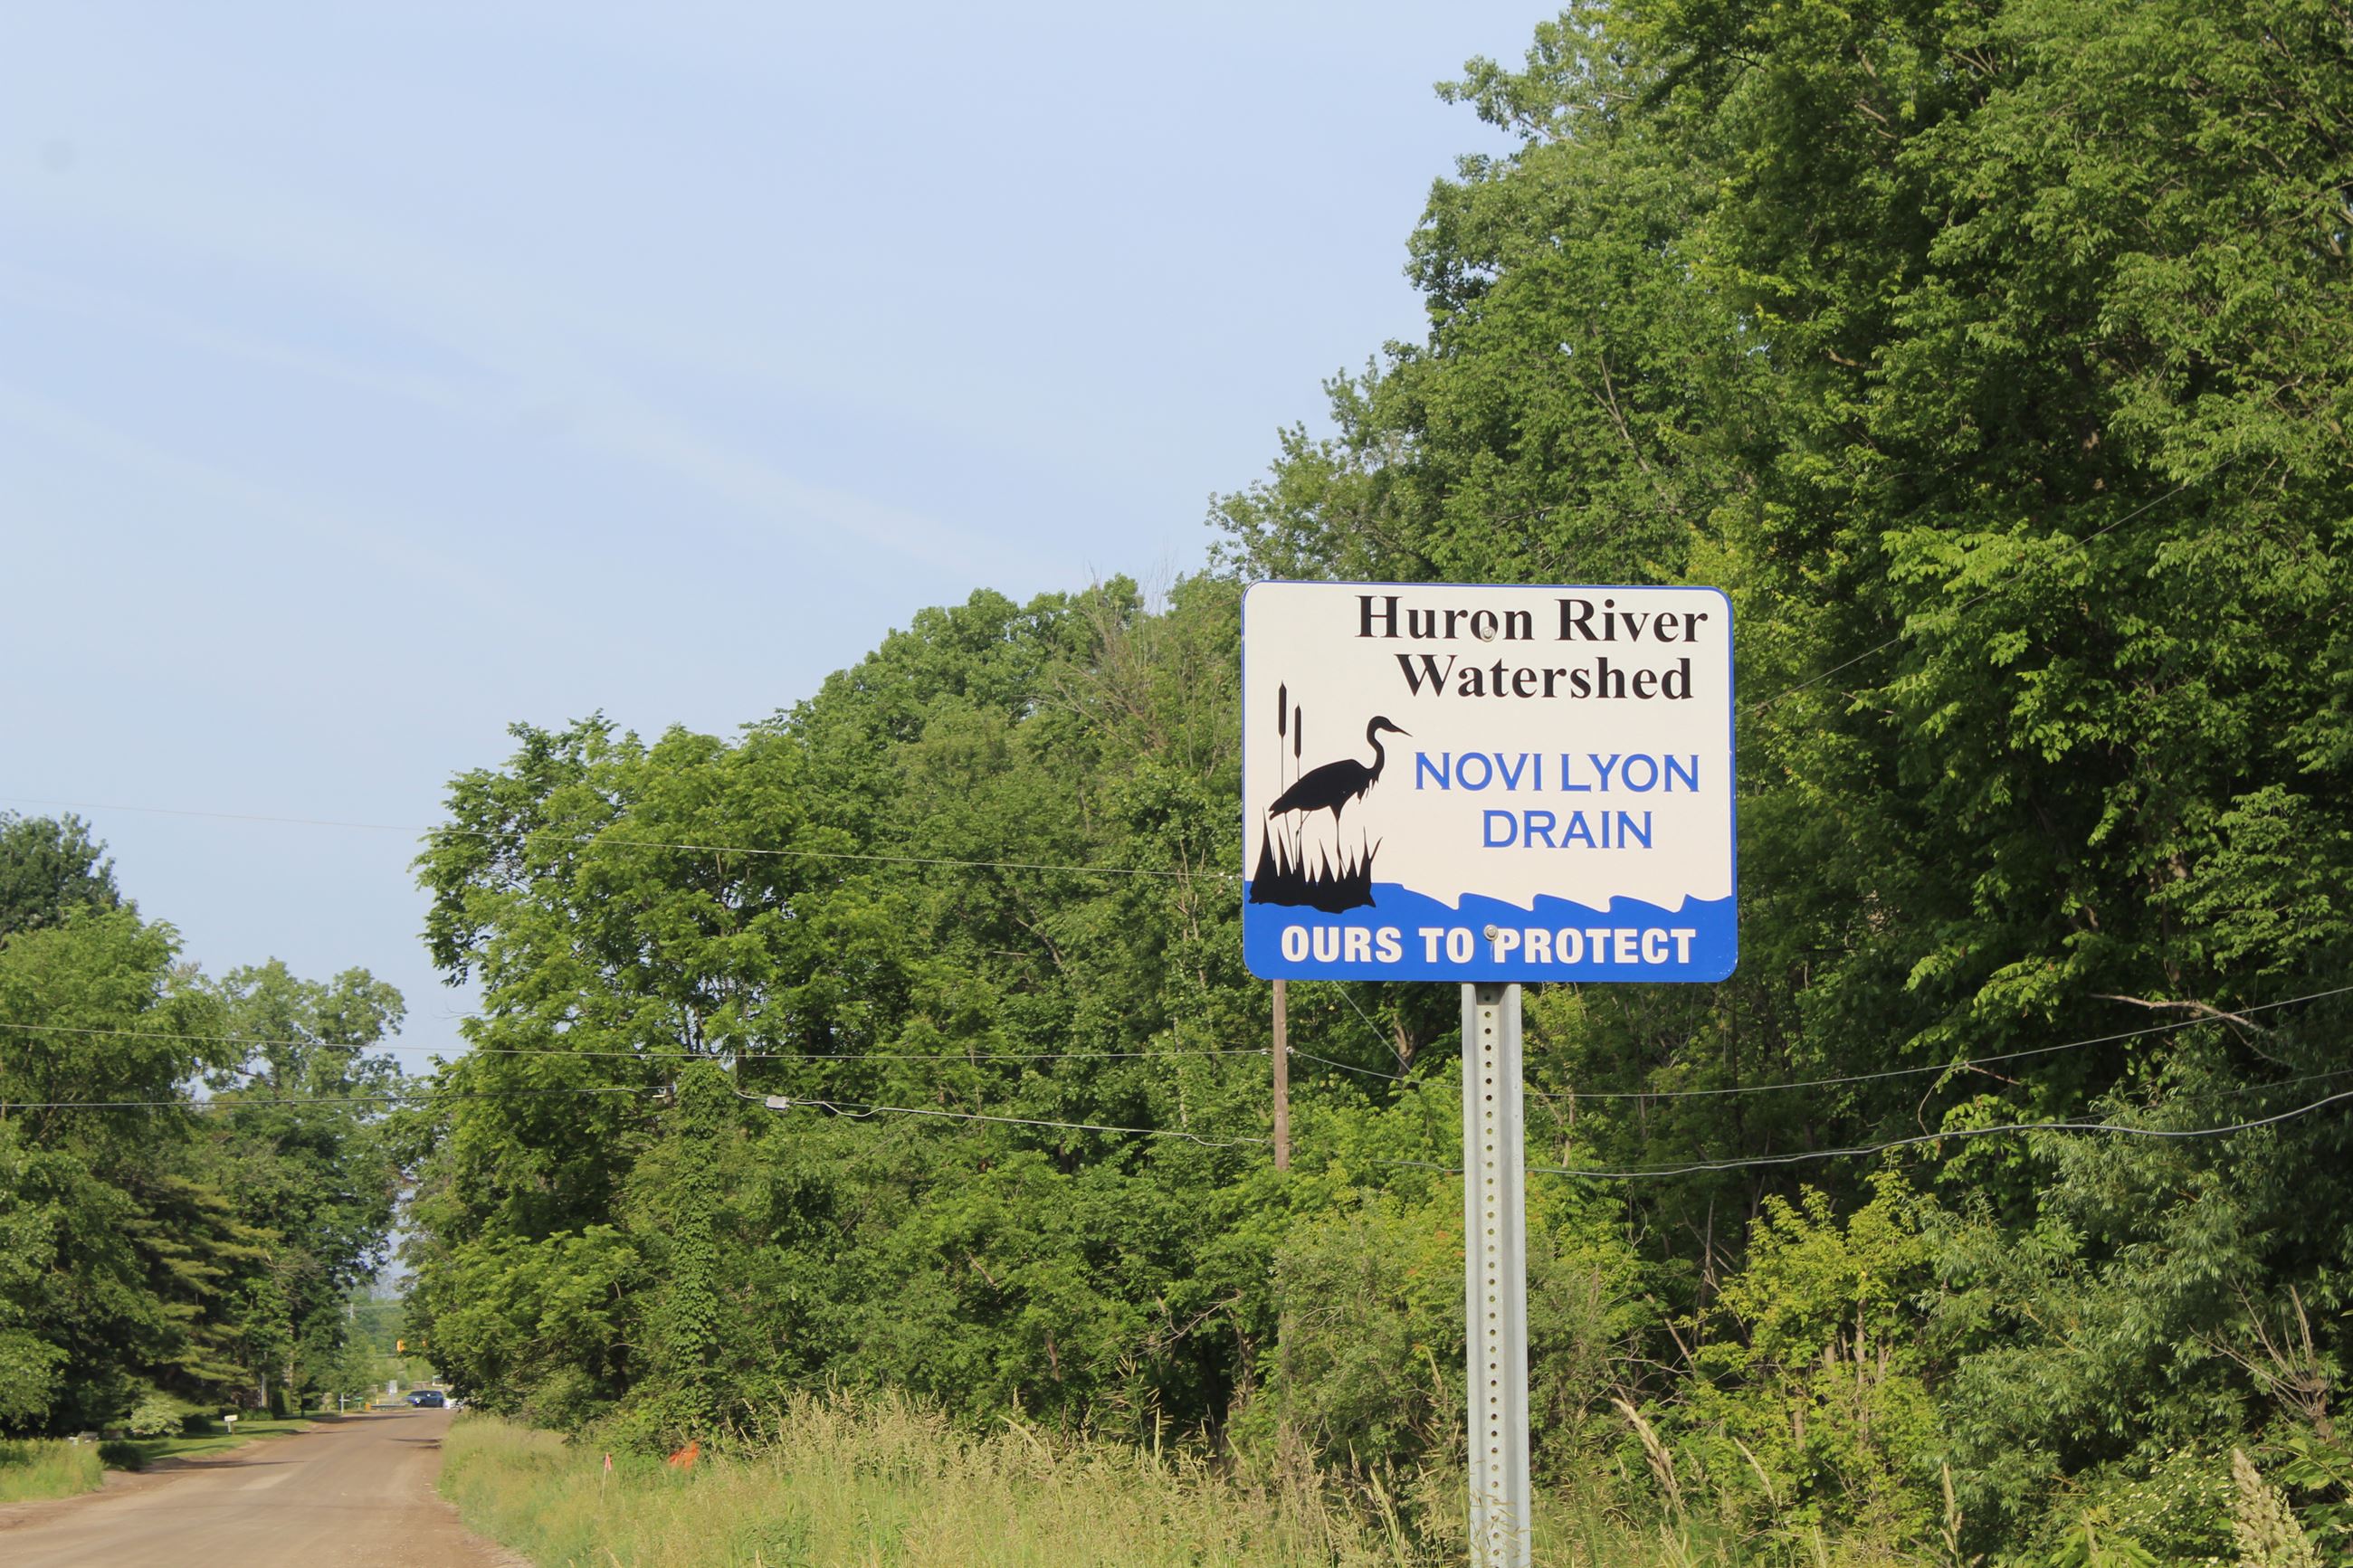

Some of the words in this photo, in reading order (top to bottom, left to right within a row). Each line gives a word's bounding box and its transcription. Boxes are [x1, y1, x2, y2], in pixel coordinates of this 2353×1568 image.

[1356, 595, 1535, 641] Huron
[1555, 599, 1709, 642] River
[1395, 653, 1693, 699] Watershed
[1415, 752, 1542, 791] NOVI
[1561, 754, 1700, 793] LYON
[1482, 810, 1653, 849] DRAIN
[1281, 926, 1403, 964] OURS
[1419, 927, 1474, 964] TO
[1492, 927, 1696, 965] PROTECT
